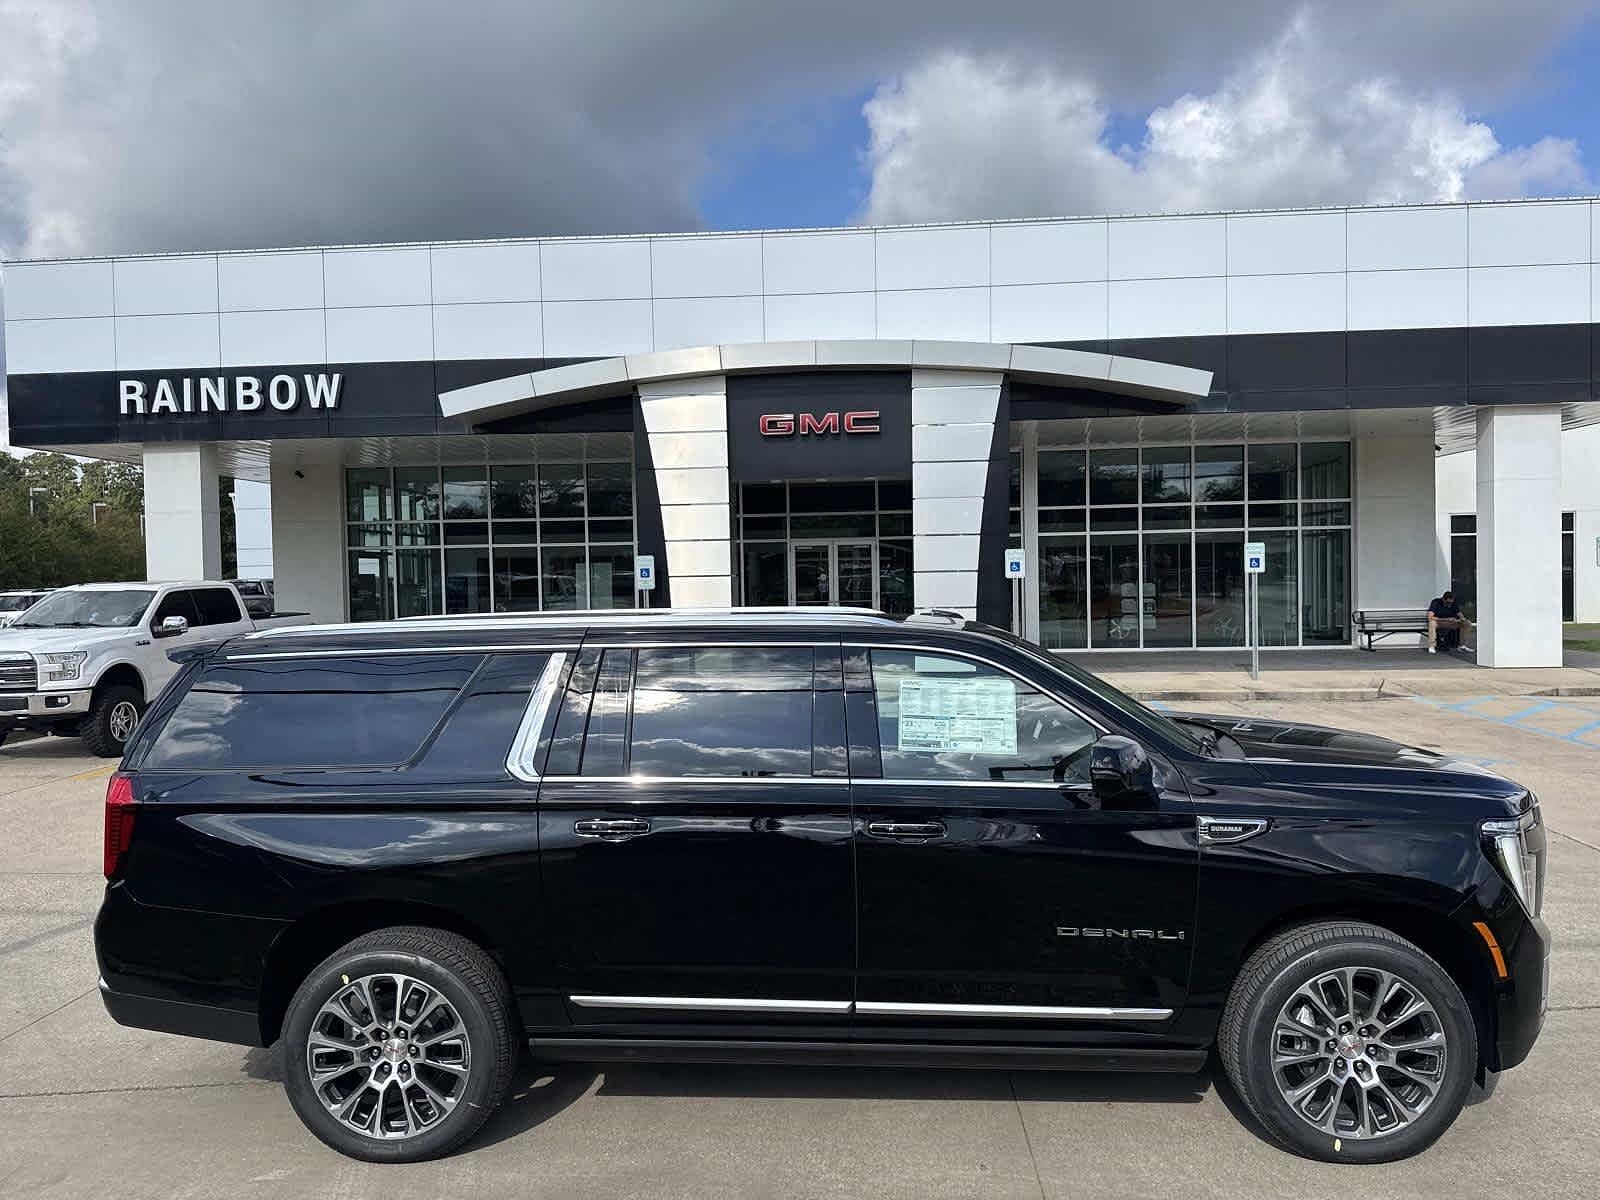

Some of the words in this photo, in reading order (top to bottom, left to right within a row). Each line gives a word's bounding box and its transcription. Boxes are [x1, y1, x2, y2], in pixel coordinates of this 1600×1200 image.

[119, 373, 341, 414] RAINBOW
[760, 411, 880, 435] GMC
[1056, 926, 1185, 940] DENALI
